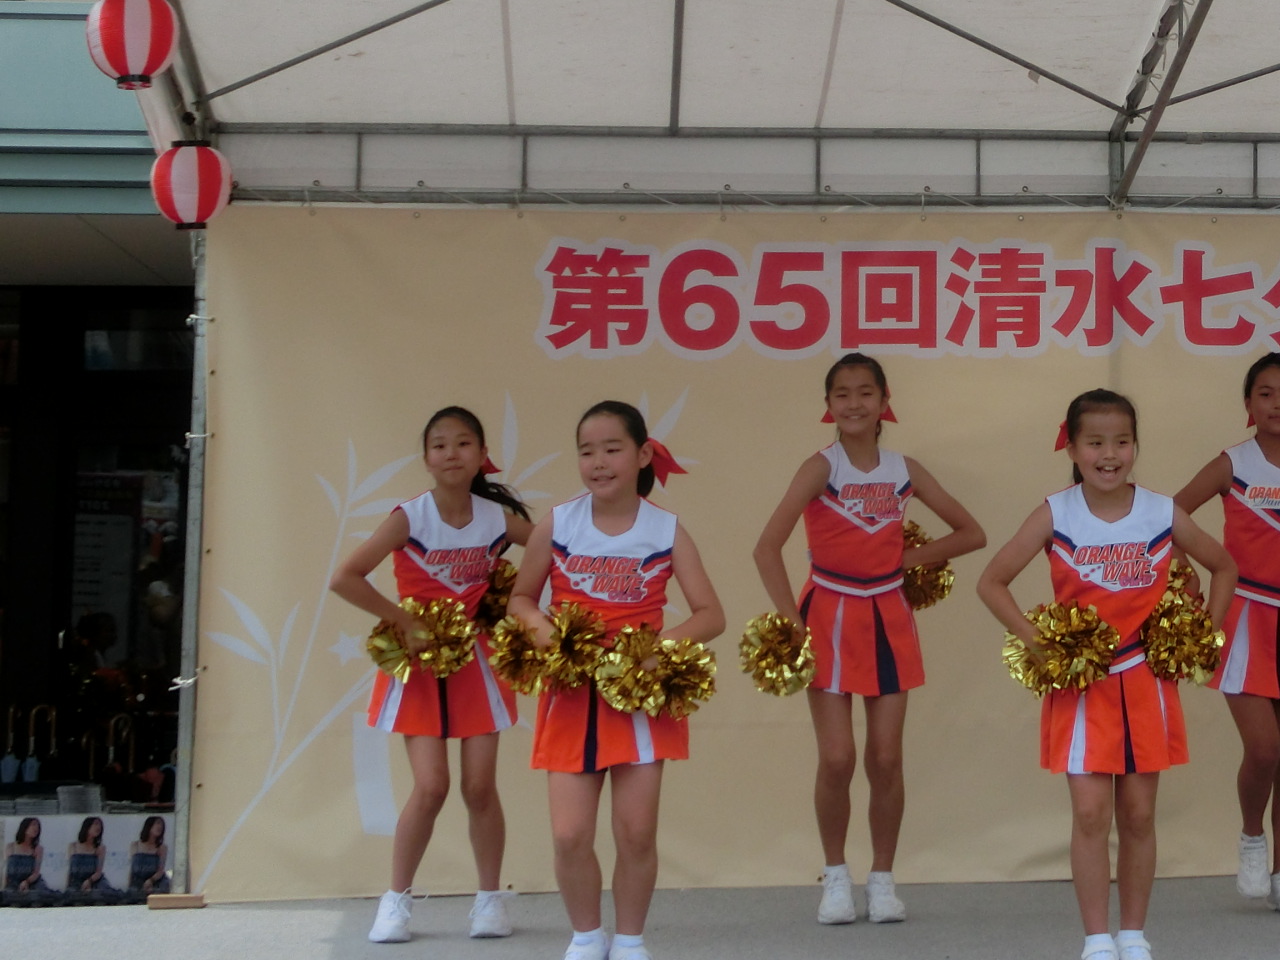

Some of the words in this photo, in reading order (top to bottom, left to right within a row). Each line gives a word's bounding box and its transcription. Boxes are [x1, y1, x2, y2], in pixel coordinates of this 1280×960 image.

[840, 482, 897, 500] ORANGE
[862, 497, 901, 515] WAVE
[425, 544, 489, 565] ORANGE
[1073, 541, 1148, 566] ORANGE
[449, 560, 489, 580] WAVE
[564, 554, 643, 574] ORANGE
[1101, 559, 1153, 582] WAVE
[590, 574, 645, 593] WAVE
